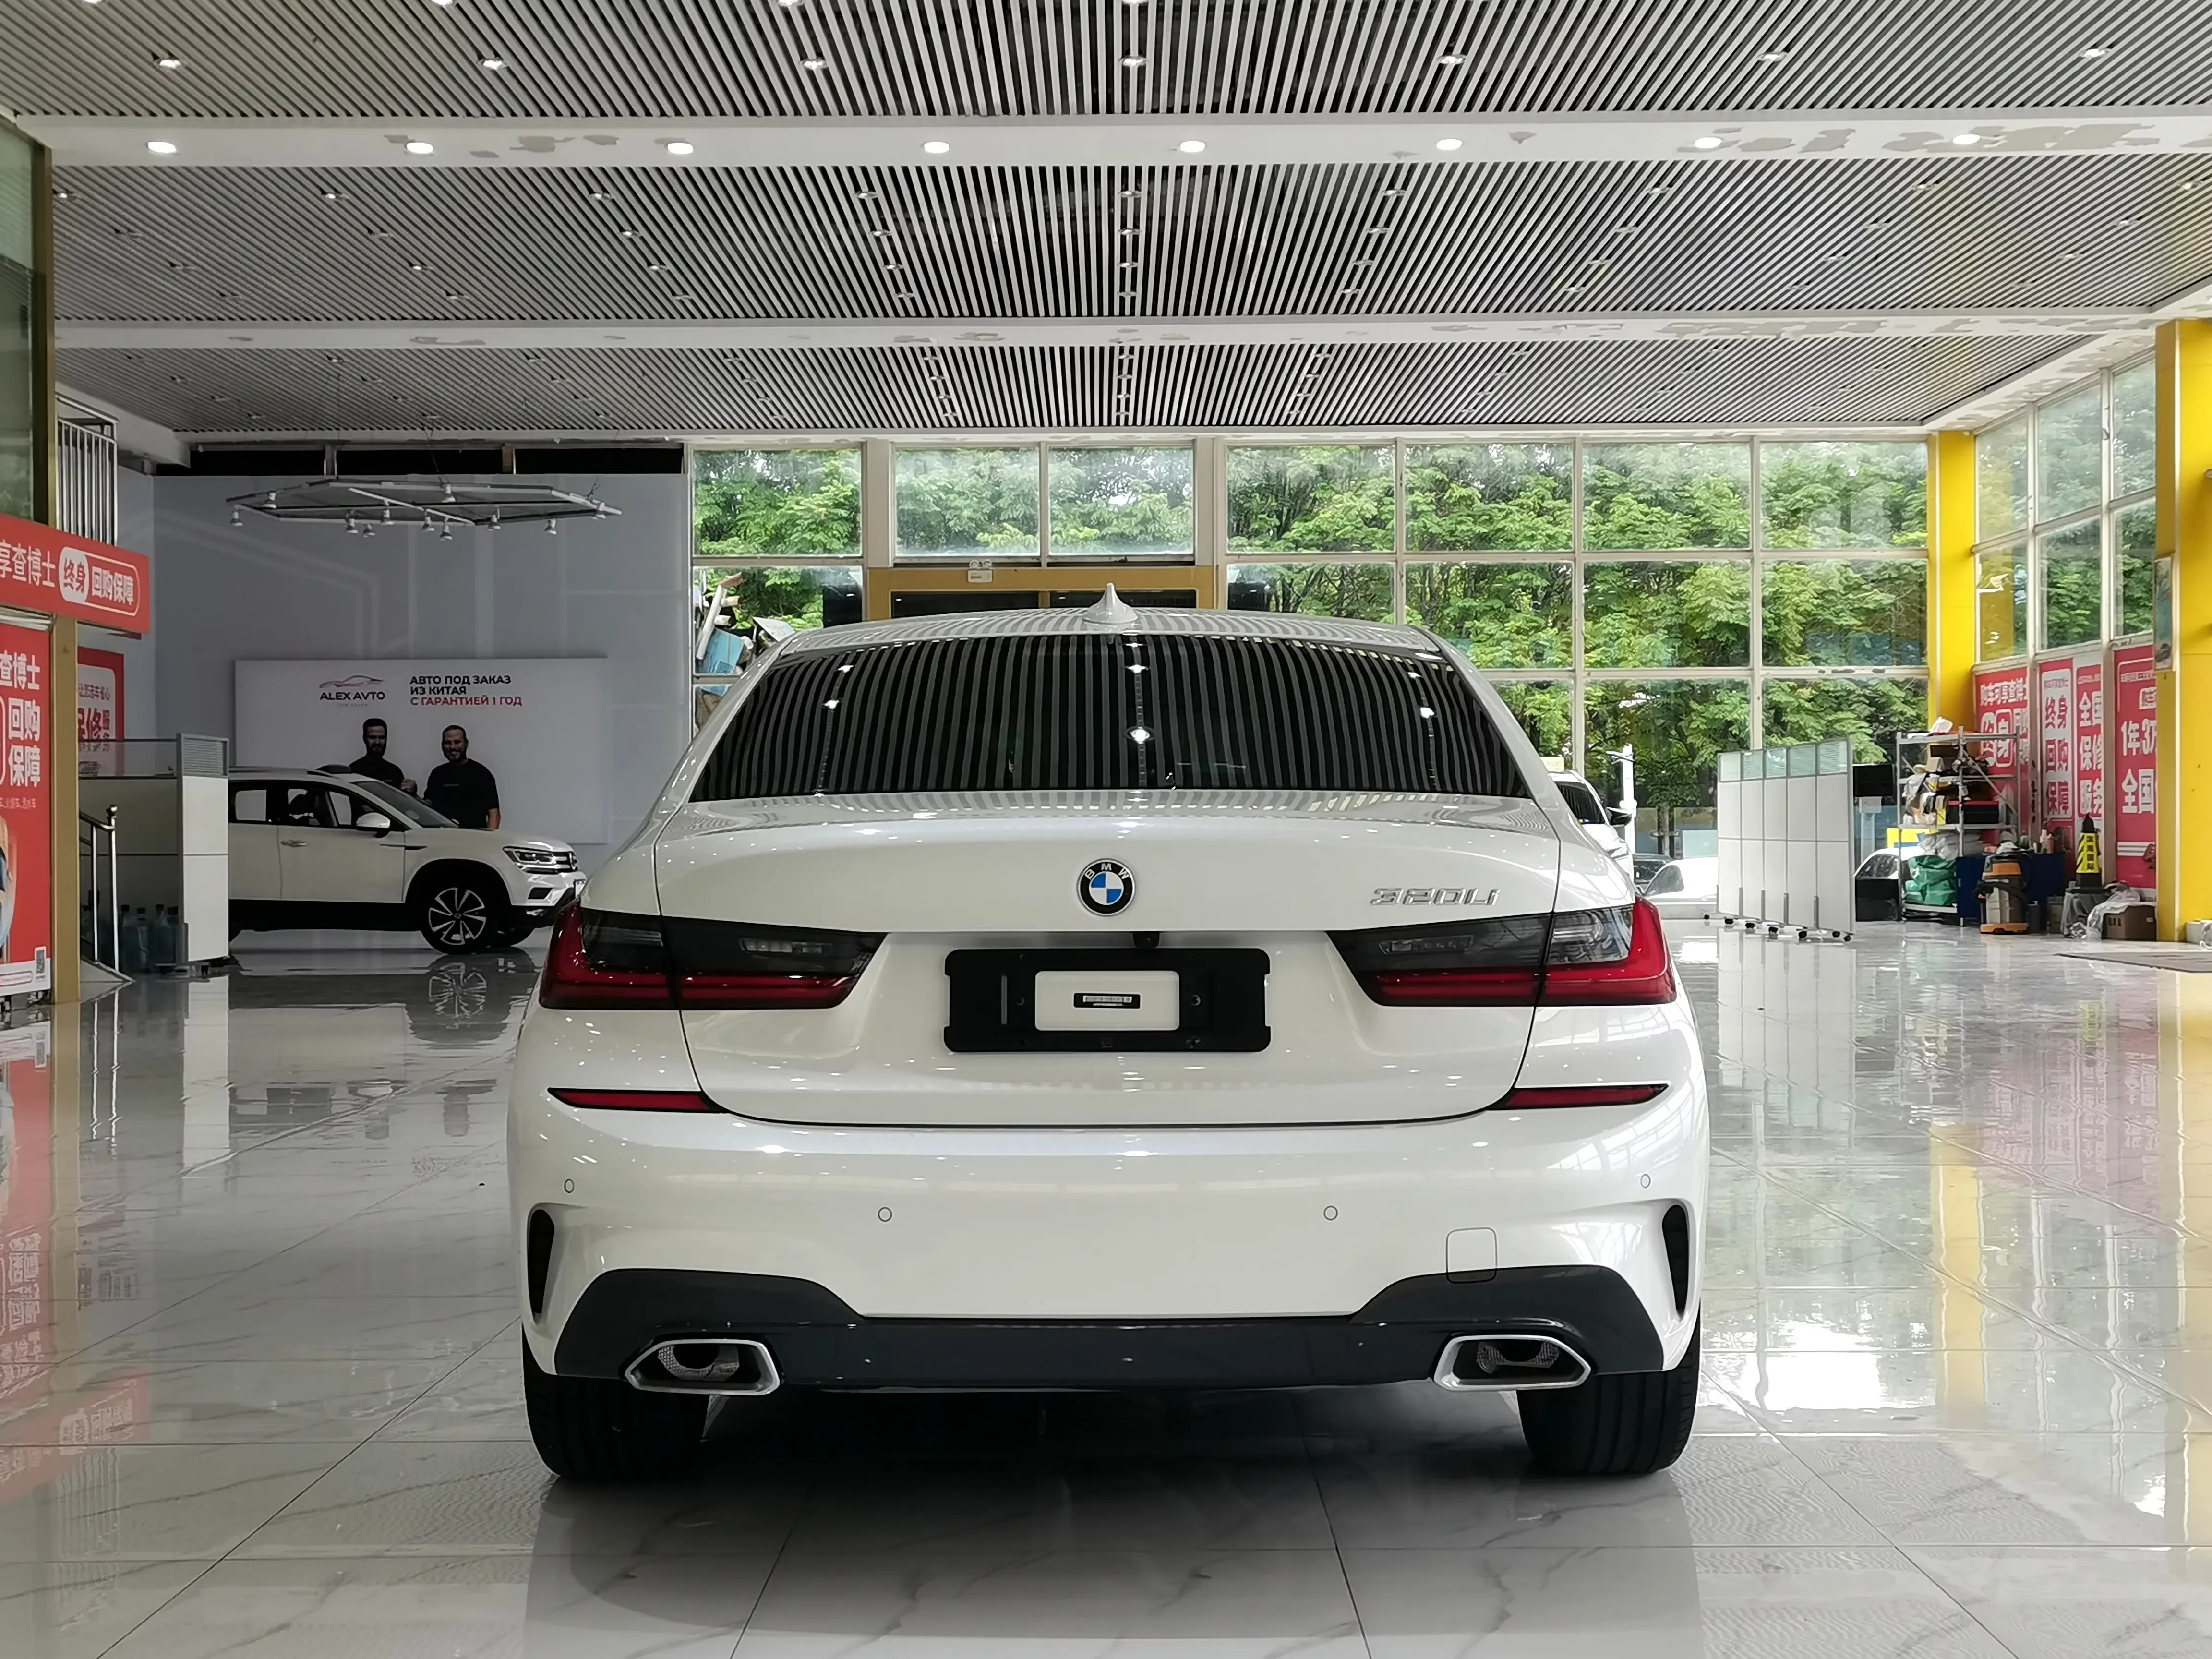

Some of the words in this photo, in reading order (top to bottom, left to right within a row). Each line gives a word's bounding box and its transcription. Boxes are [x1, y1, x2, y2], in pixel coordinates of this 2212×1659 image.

[91, 565, 134, 606] 回购保障
[410, 675, 441, 685] АВТО
[445, 675, 471, 685] ПОД
[472, 675, 512, 685] ЗАКАЗ
[410, 686, 426, 695] ИЗ
[429, 686, 467, 695] КИТАЯ
[410, 697, 419, 706] С
[421, 695, 489, 706] ГАРАНТИЕЙ
[493, 697, 496, 705] 1
[500, 697, 522, 707] ГОД
[8, 697, 40, 742] 回购
[8, 745, 40, 787] 保障
[2122, 768, 2154, 814] 全国
[1084, 863, 1131, 880] BMW
